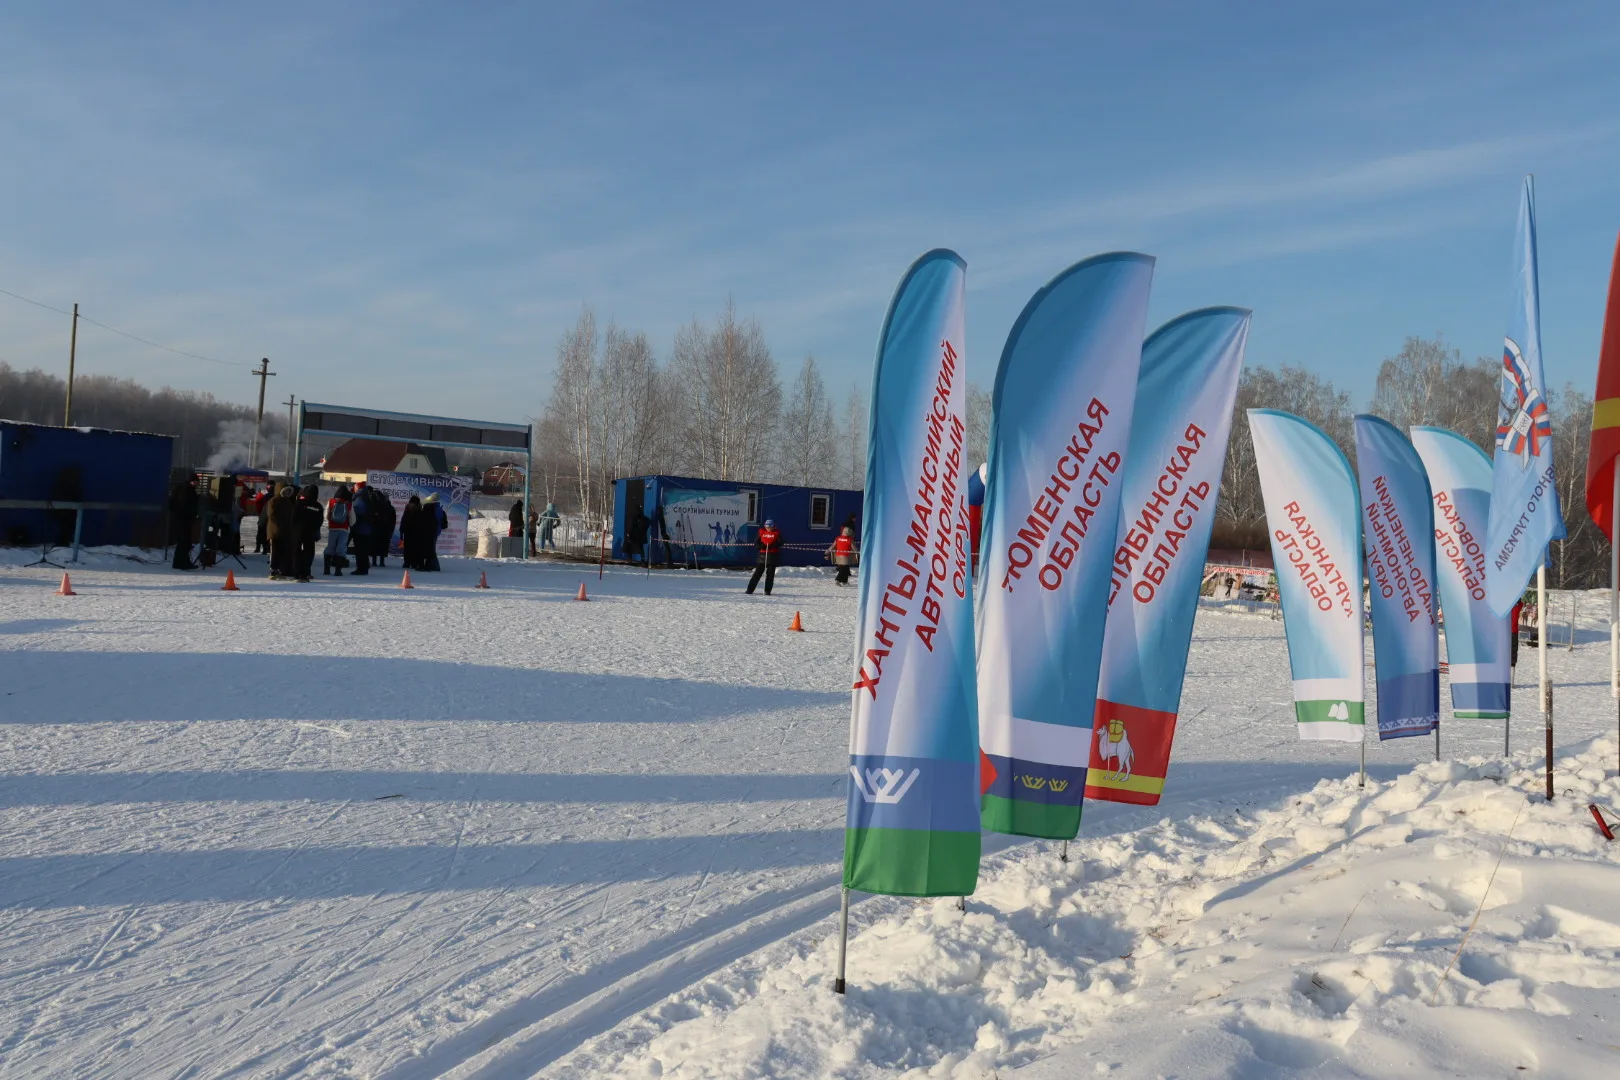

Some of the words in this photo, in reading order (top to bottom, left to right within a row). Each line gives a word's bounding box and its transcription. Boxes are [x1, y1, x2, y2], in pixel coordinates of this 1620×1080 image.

[370, 473, 453, 488] СПОРТИВНЫЙ
[673, 505, 715, 515] СПОРТИВНЫЙ
[716, 507, 740, 516] ТУРИЗМ
[853, 340, 959, 700] ХАНТЫ-МАНСИЙСКИЙ
[914, 413, 966, 653] АВТОНОМНЫЙ
[1038, 451, 1121, 591] ОБЛАСТЬ
[1107, 423, 1207, 613] ЛЯБИНСКАЯ
[1132, 481, 1210, 604] ОБЛАСТЬ
[952, 494, 972, 599] ОКРУГ
